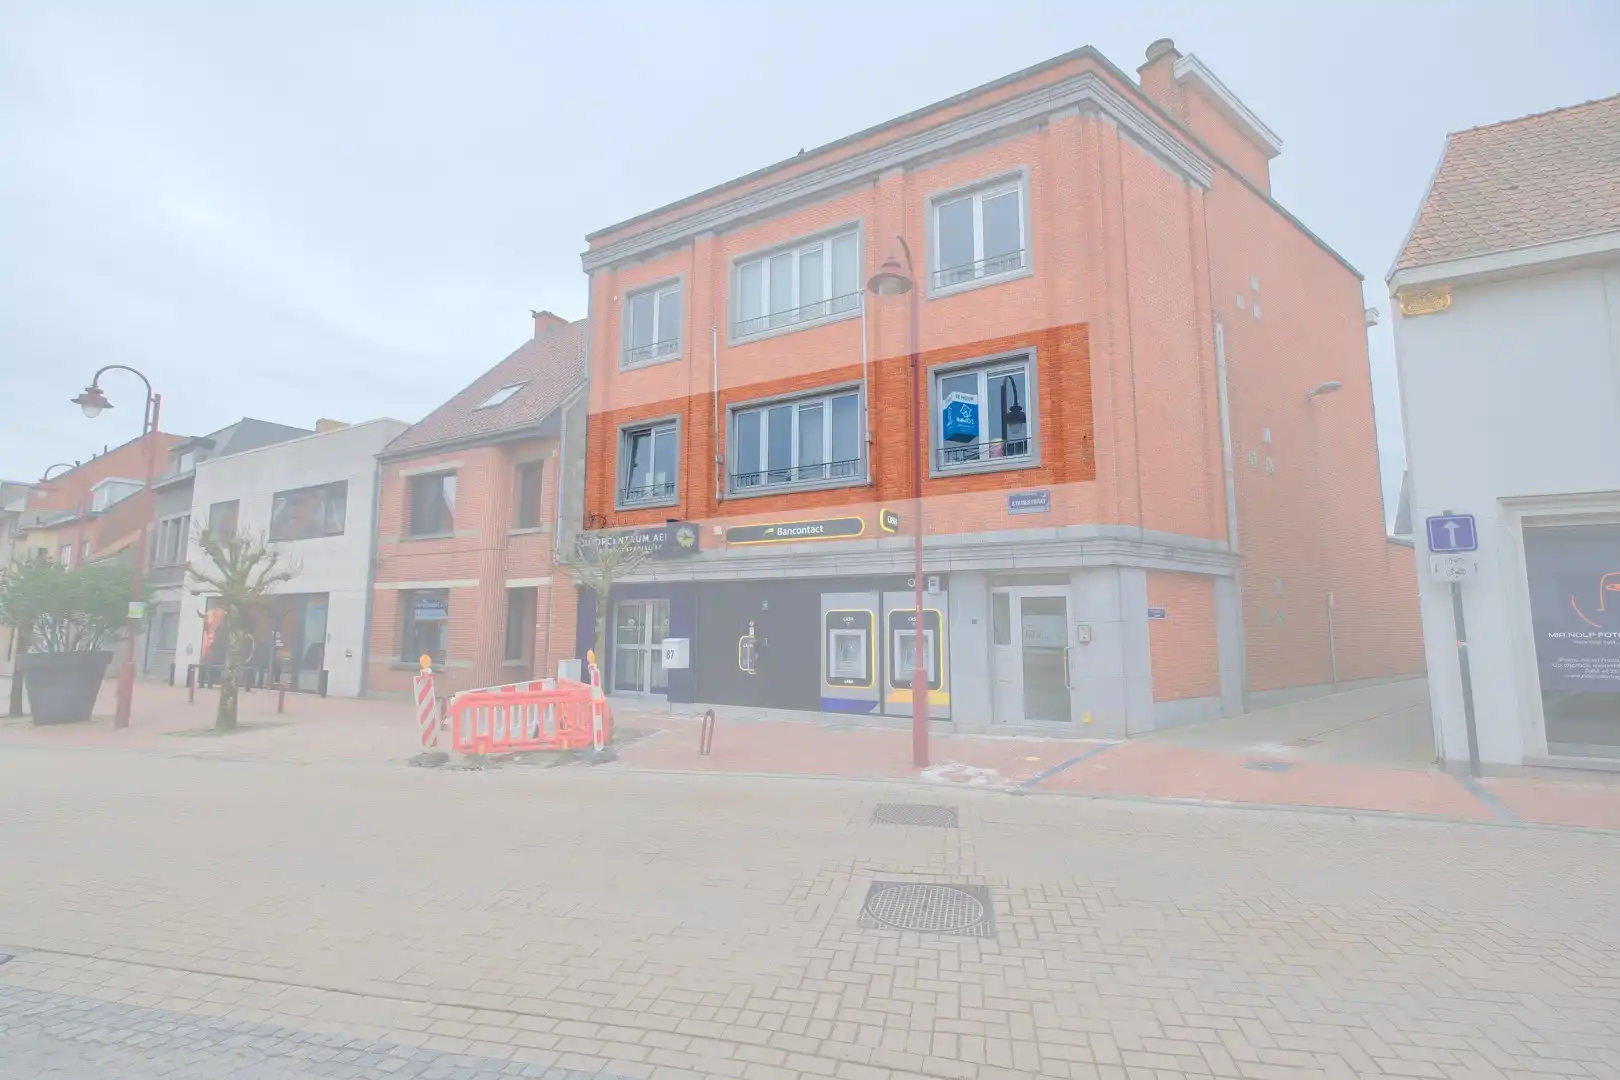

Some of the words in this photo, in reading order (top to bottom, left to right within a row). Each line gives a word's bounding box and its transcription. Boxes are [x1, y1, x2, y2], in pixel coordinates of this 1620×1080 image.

[777, 524, 824, 536] Bancontact
[652, 532, 667, 542] AE
[665, 649, 675, 660] 87
